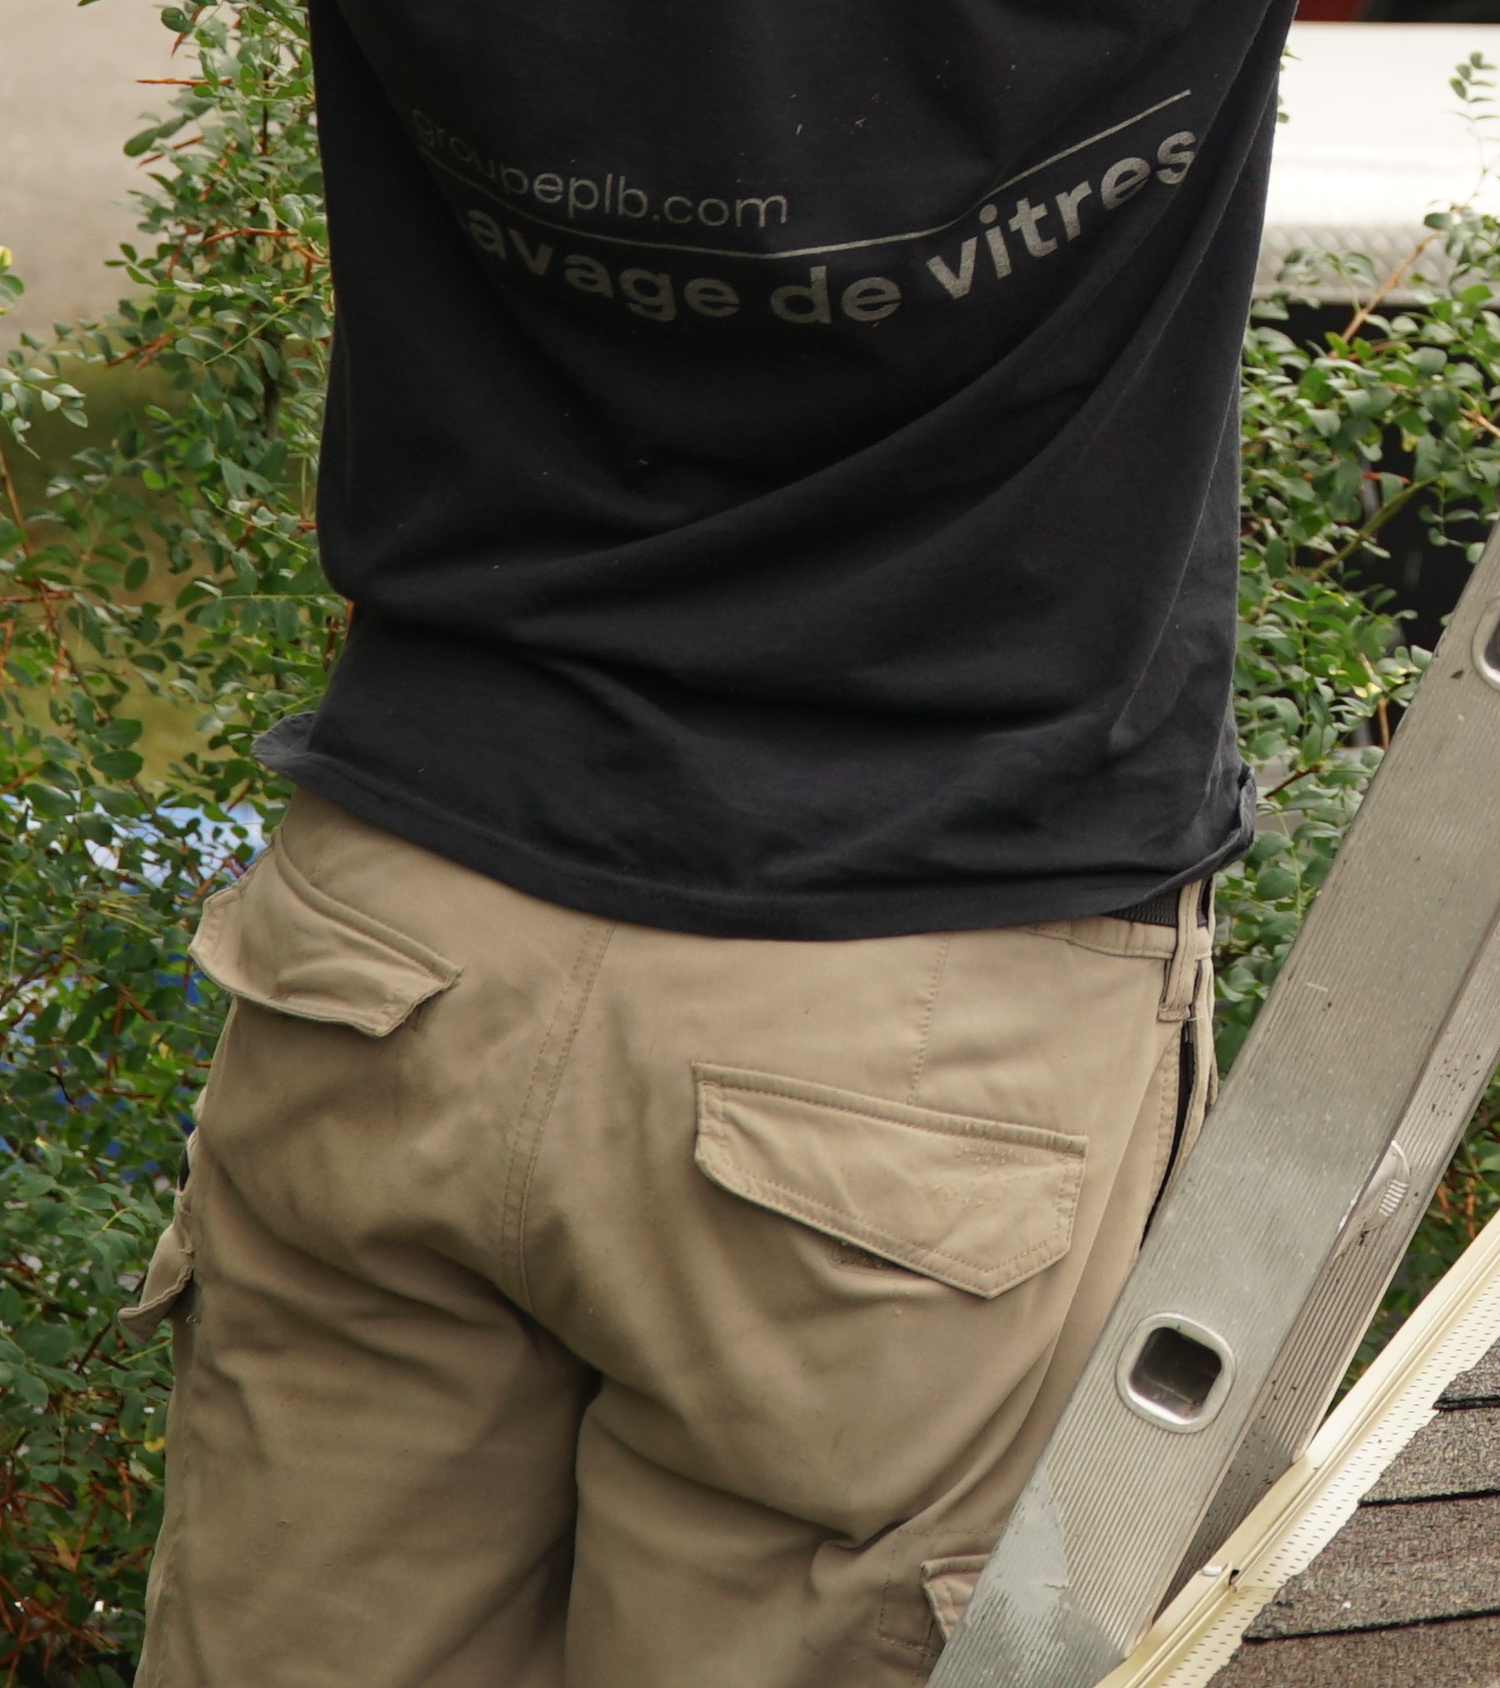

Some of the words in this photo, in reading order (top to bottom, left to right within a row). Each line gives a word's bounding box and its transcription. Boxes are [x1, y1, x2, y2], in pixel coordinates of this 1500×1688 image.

[464, 209, 740, 324] avage
[770, 265, 901, 325] de
[926, 127, 1196, 301] vitres
